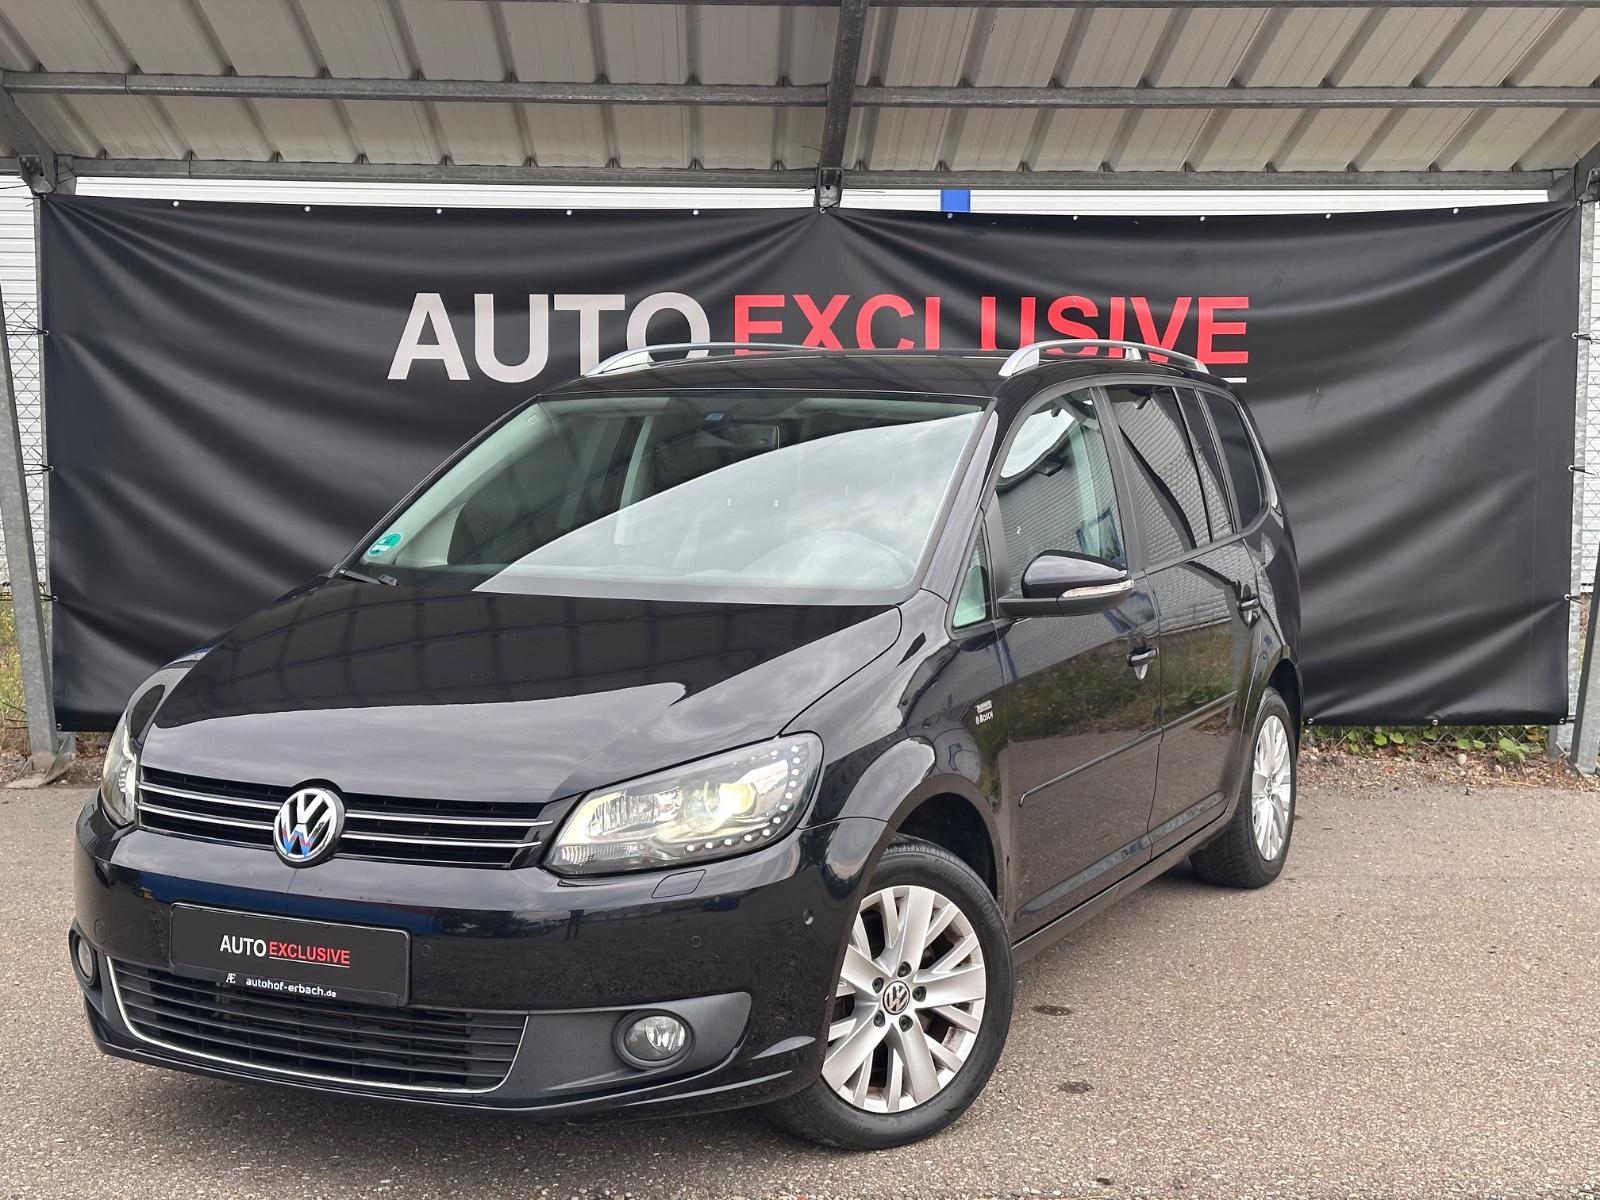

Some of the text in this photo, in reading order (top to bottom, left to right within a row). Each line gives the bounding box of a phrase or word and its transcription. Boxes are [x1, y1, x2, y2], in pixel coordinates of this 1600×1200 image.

[387, 291, 711, 383] AUTO
[219, 935, 351, 965] AUTO EXCLUSIVE
[246, 976, 337, 998] autohof-erbach.de
